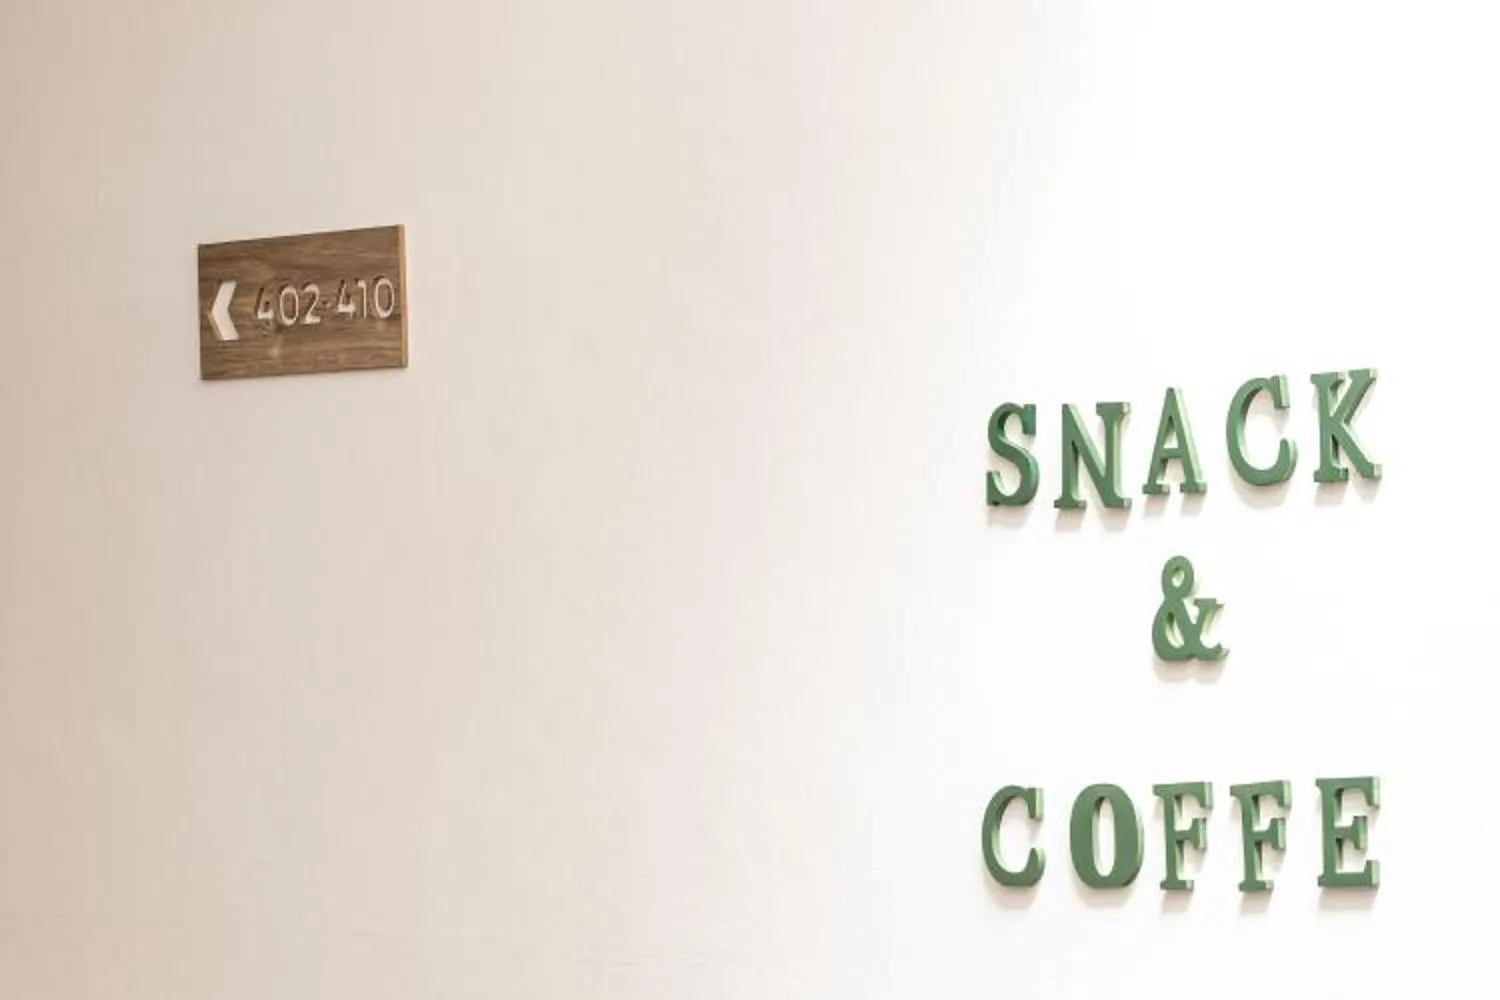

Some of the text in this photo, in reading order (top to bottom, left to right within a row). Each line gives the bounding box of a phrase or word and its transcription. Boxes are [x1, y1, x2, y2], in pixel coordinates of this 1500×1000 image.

[986, 368, 1382, 510] SNACK
[1151, 555, 1230, 662] &
[981, 776, 1381, 892] COFFE
